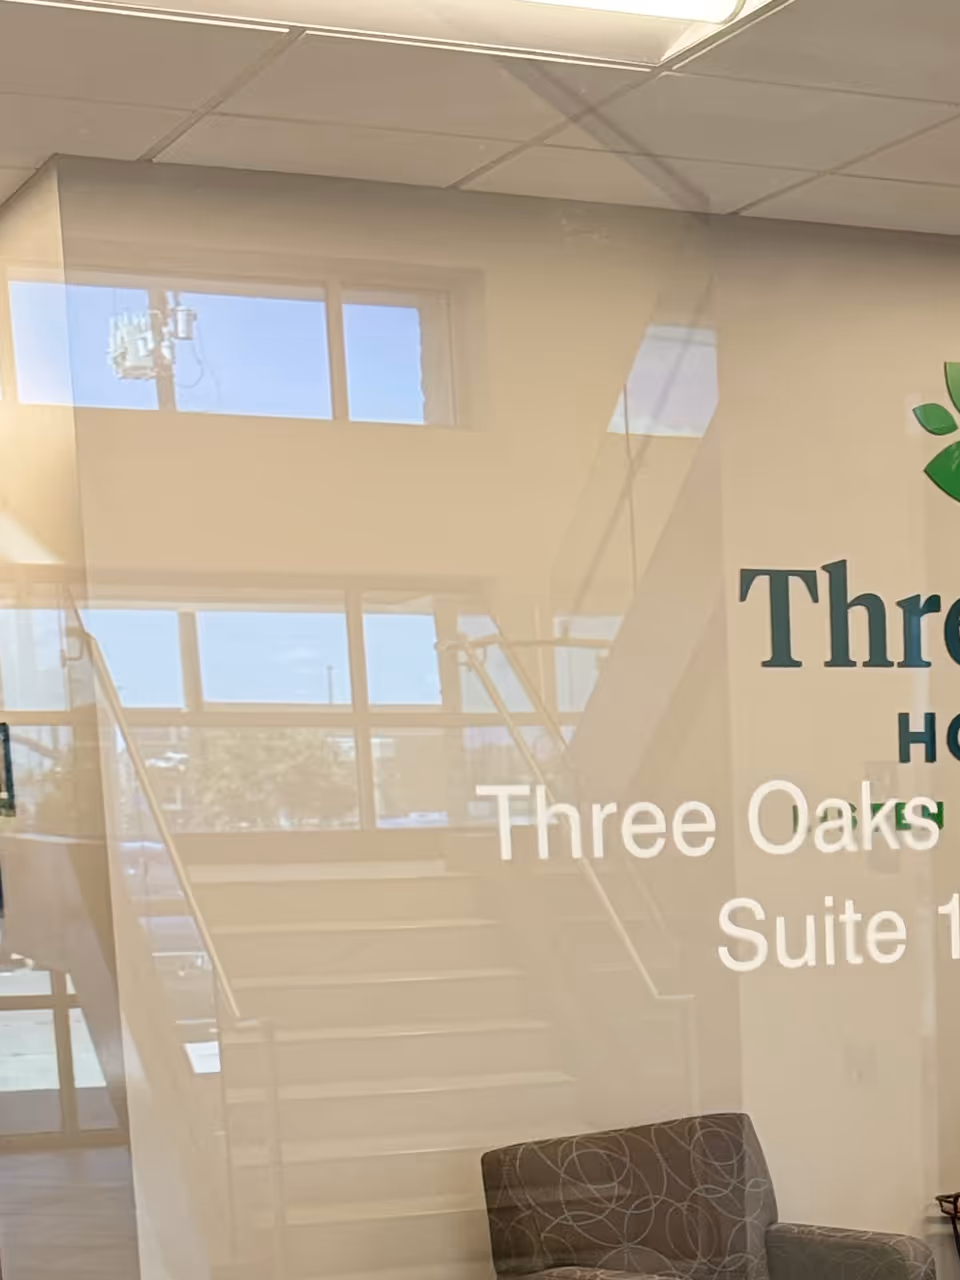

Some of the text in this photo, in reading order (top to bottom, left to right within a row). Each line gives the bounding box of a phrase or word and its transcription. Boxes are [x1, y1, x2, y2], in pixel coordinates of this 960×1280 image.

[475, 783, 717, 861] Three
[747, 779, 941, 855] Oaks
[717, 895, 908, 972] Suite
